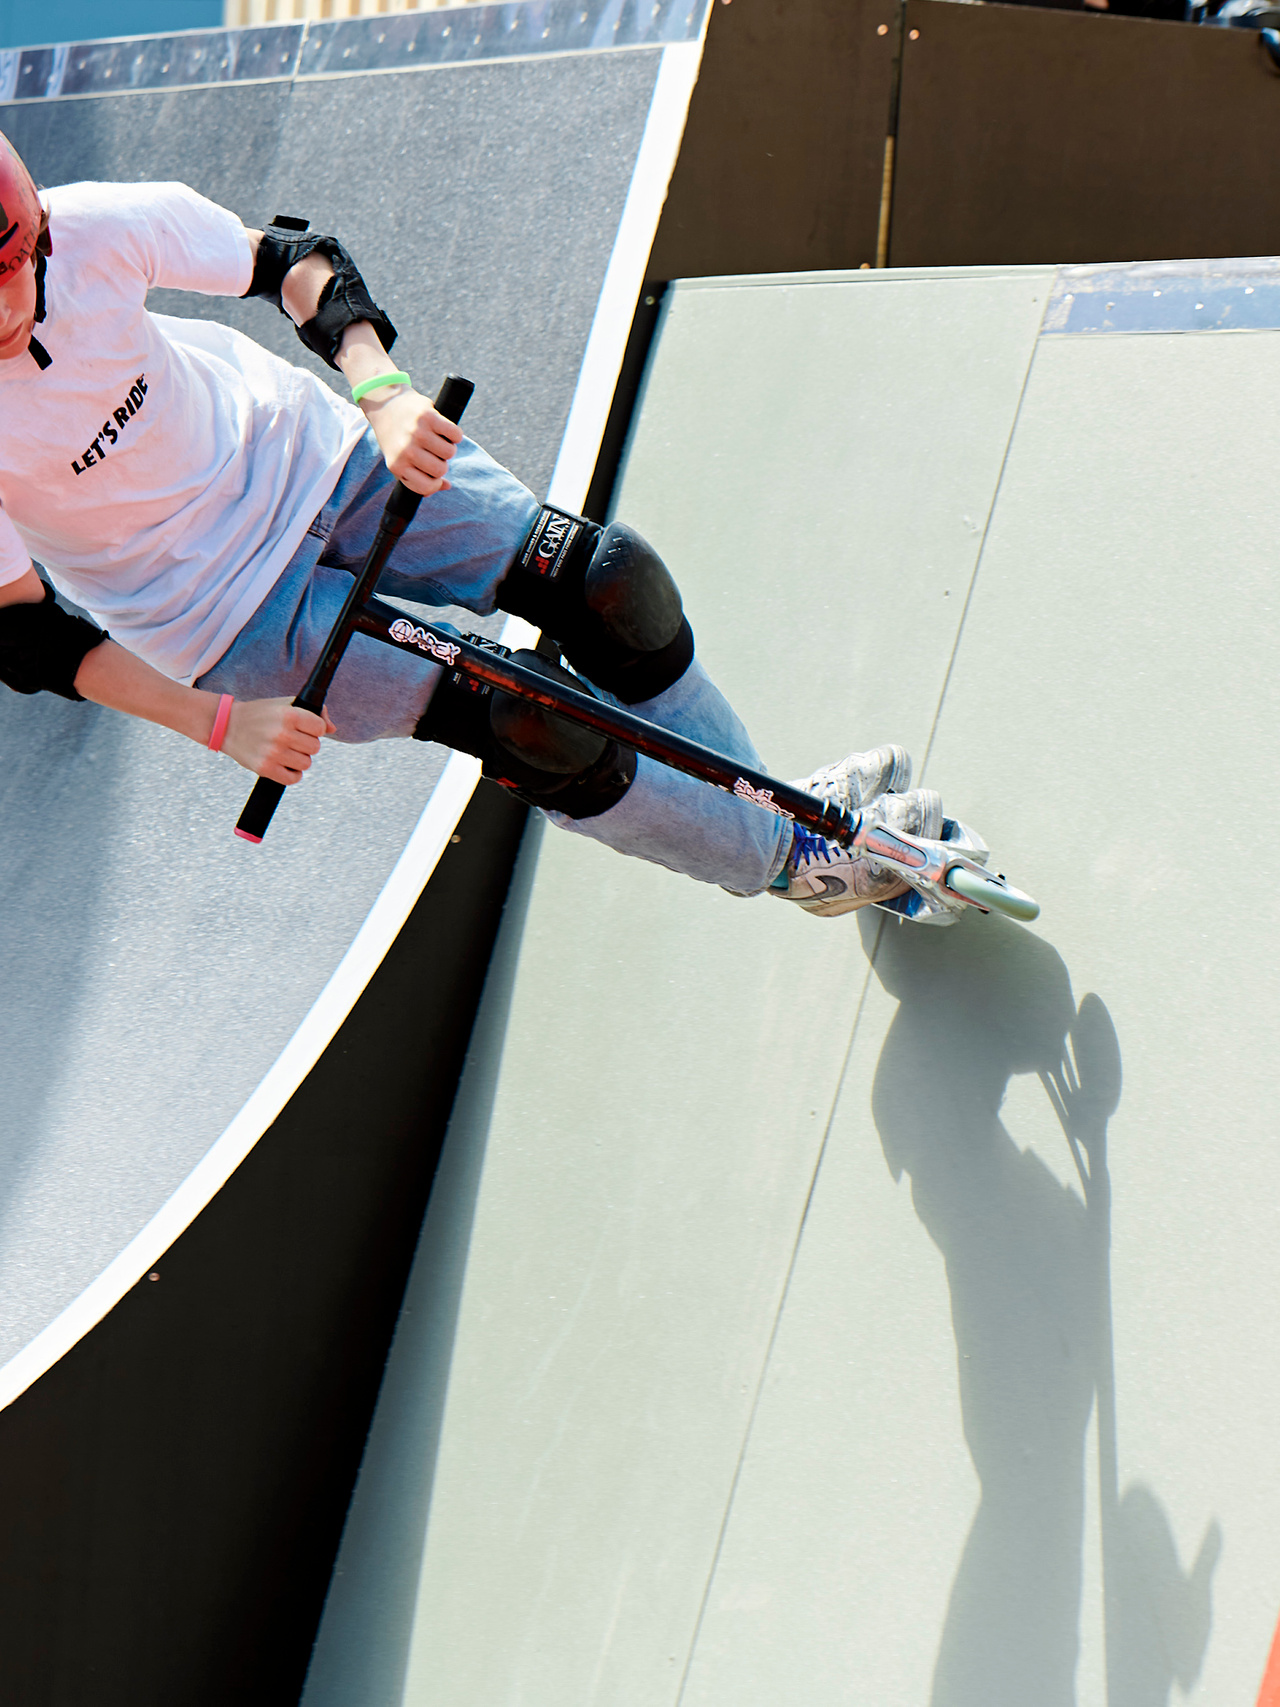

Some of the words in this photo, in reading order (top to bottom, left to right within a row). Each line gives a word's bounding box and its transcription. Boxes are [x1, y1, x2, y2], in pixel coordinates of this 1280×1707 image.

[71, 420, 118, 475] LET'S
[113, 373, 148, 429] RIDE
[538, 513, 570, 559] GAIN
